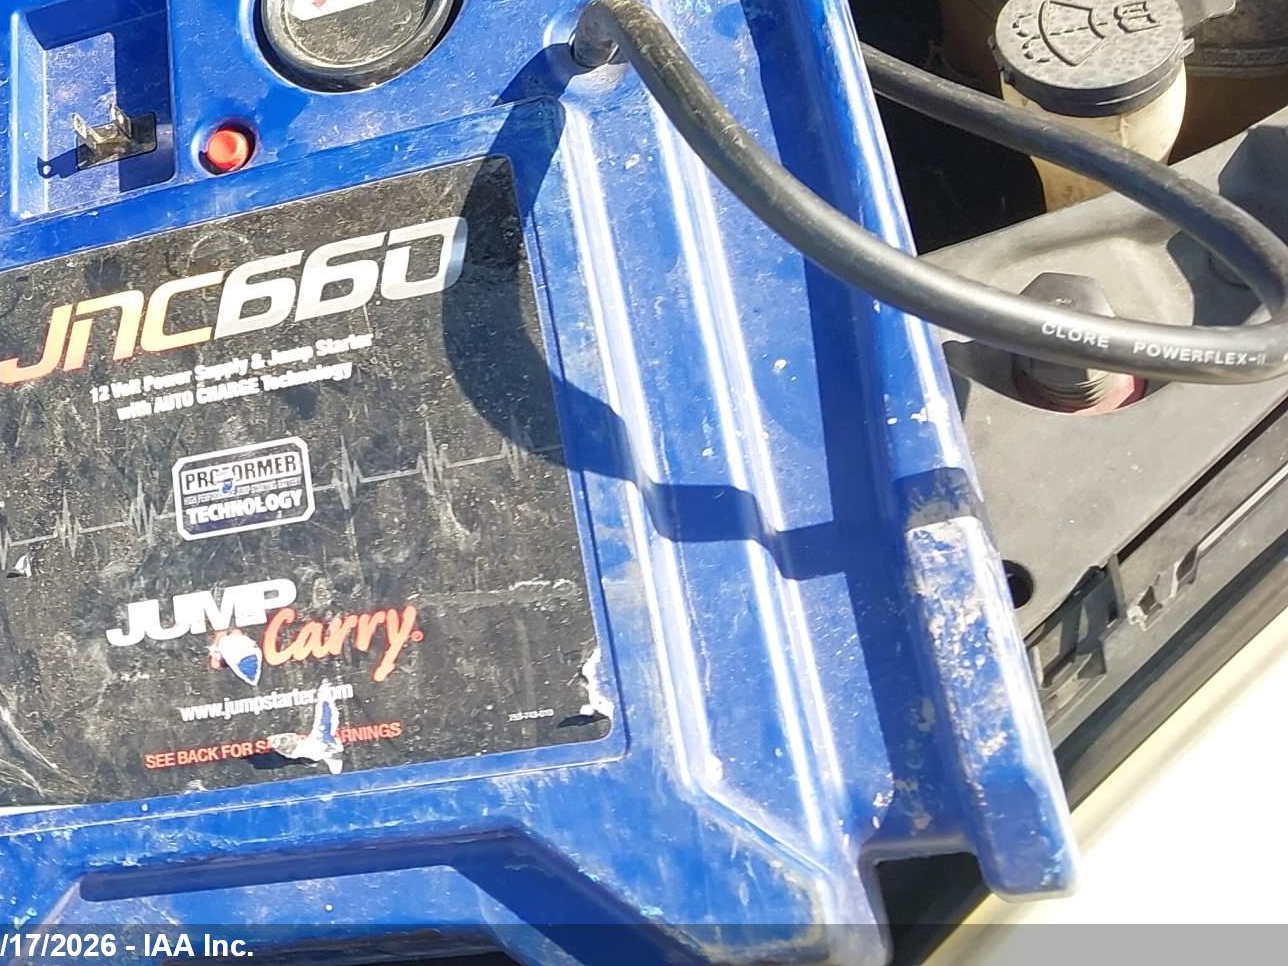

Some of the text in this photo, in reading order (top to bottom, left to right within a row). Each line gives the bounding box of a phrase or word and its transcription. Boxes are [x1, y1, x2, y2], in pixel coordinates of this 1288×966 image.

[1041, 320, 1110, 349] CLORE
[90, 332, 374, 404] 12 Volt Power Supply & Jump Starter
[116, 361, 353, 421] with AUTO CHARGE Technology
[184, 454, 298, 492] PROORMER
[186, 489, 303, 524] TECHNOLOGY
[106, 579, 297, 646] JUMP
[262, 607, 418, 682] Carry
[145, 752, 176, 770] SEE
[177, 746, 219, 766] BACK
[221, 742, 253, 760] FOR
